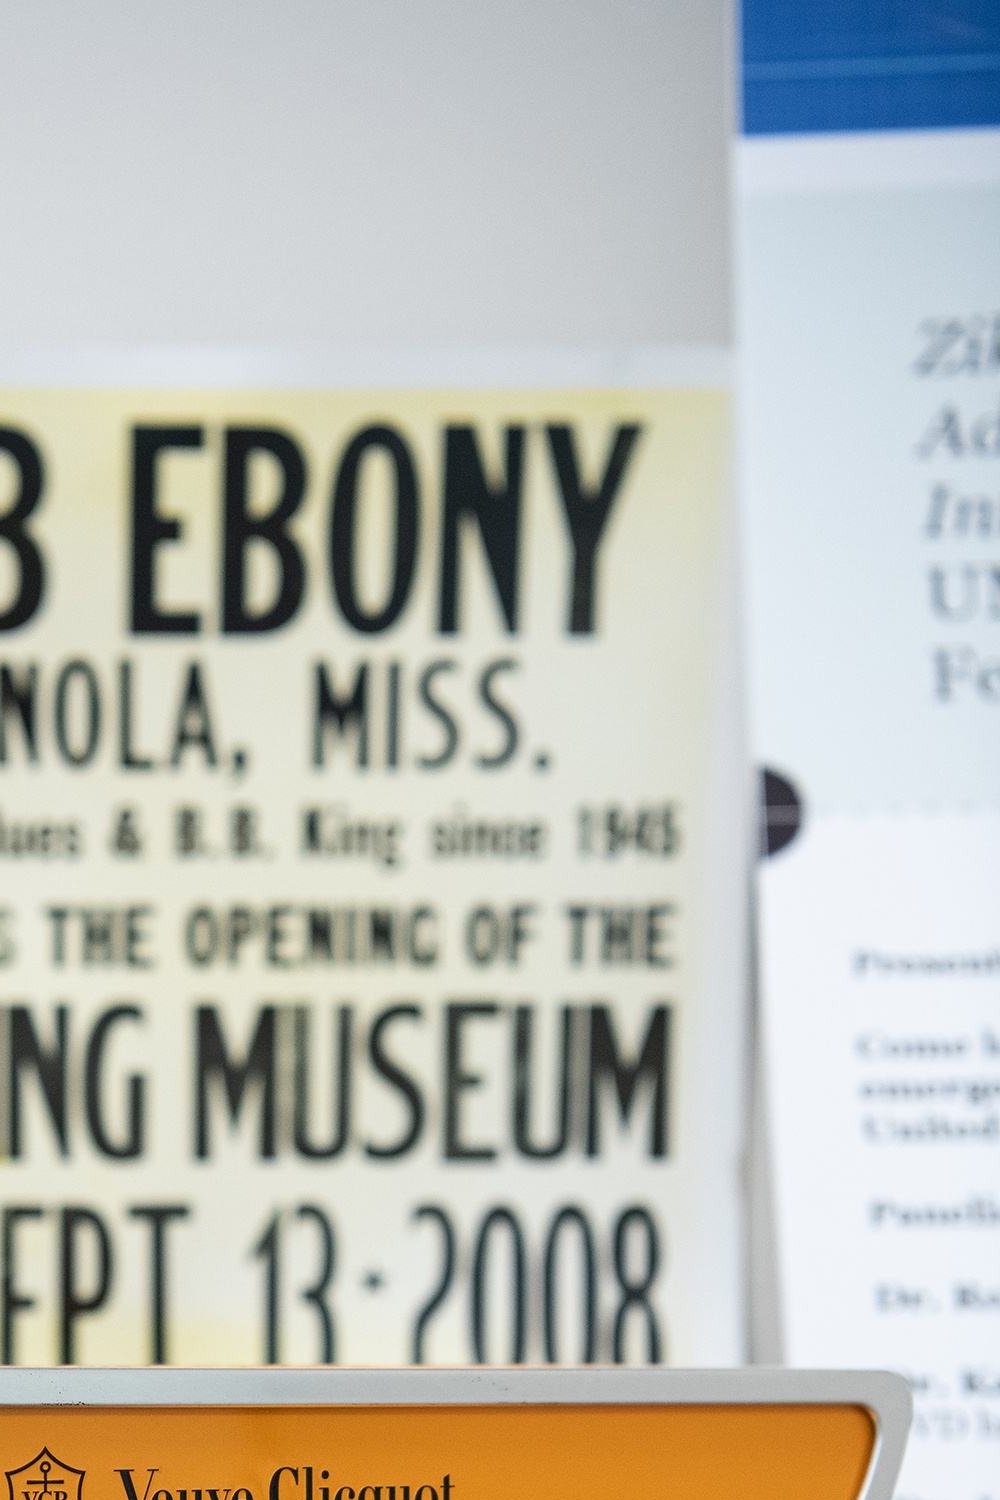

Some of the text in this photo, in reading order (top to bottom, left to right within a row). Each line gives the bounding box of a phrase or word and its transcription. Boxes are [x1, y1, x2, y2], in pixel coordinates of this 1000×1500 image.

[127, 421, 643, 638] EBONY
[313, 660, 551, 768] MISS.
[111, 808, 142, 858] &
[175, 806, 275, 858] B.B.
[302, 807, 396, 866] King
[431, 821, 545, 858] since
[579, 804, 680, 858] 1945
[47, 905, 149, 969] THE
[186, 906, 437, 967] OPENING
[464, 903, 534, 969] OF
[567, 903, 670, 969] THE
[193, 1000, 673, 1163] MUSEUM
[248, 1203, 338, 1365] 13
[412, 1203, 663, 1365] 2008
